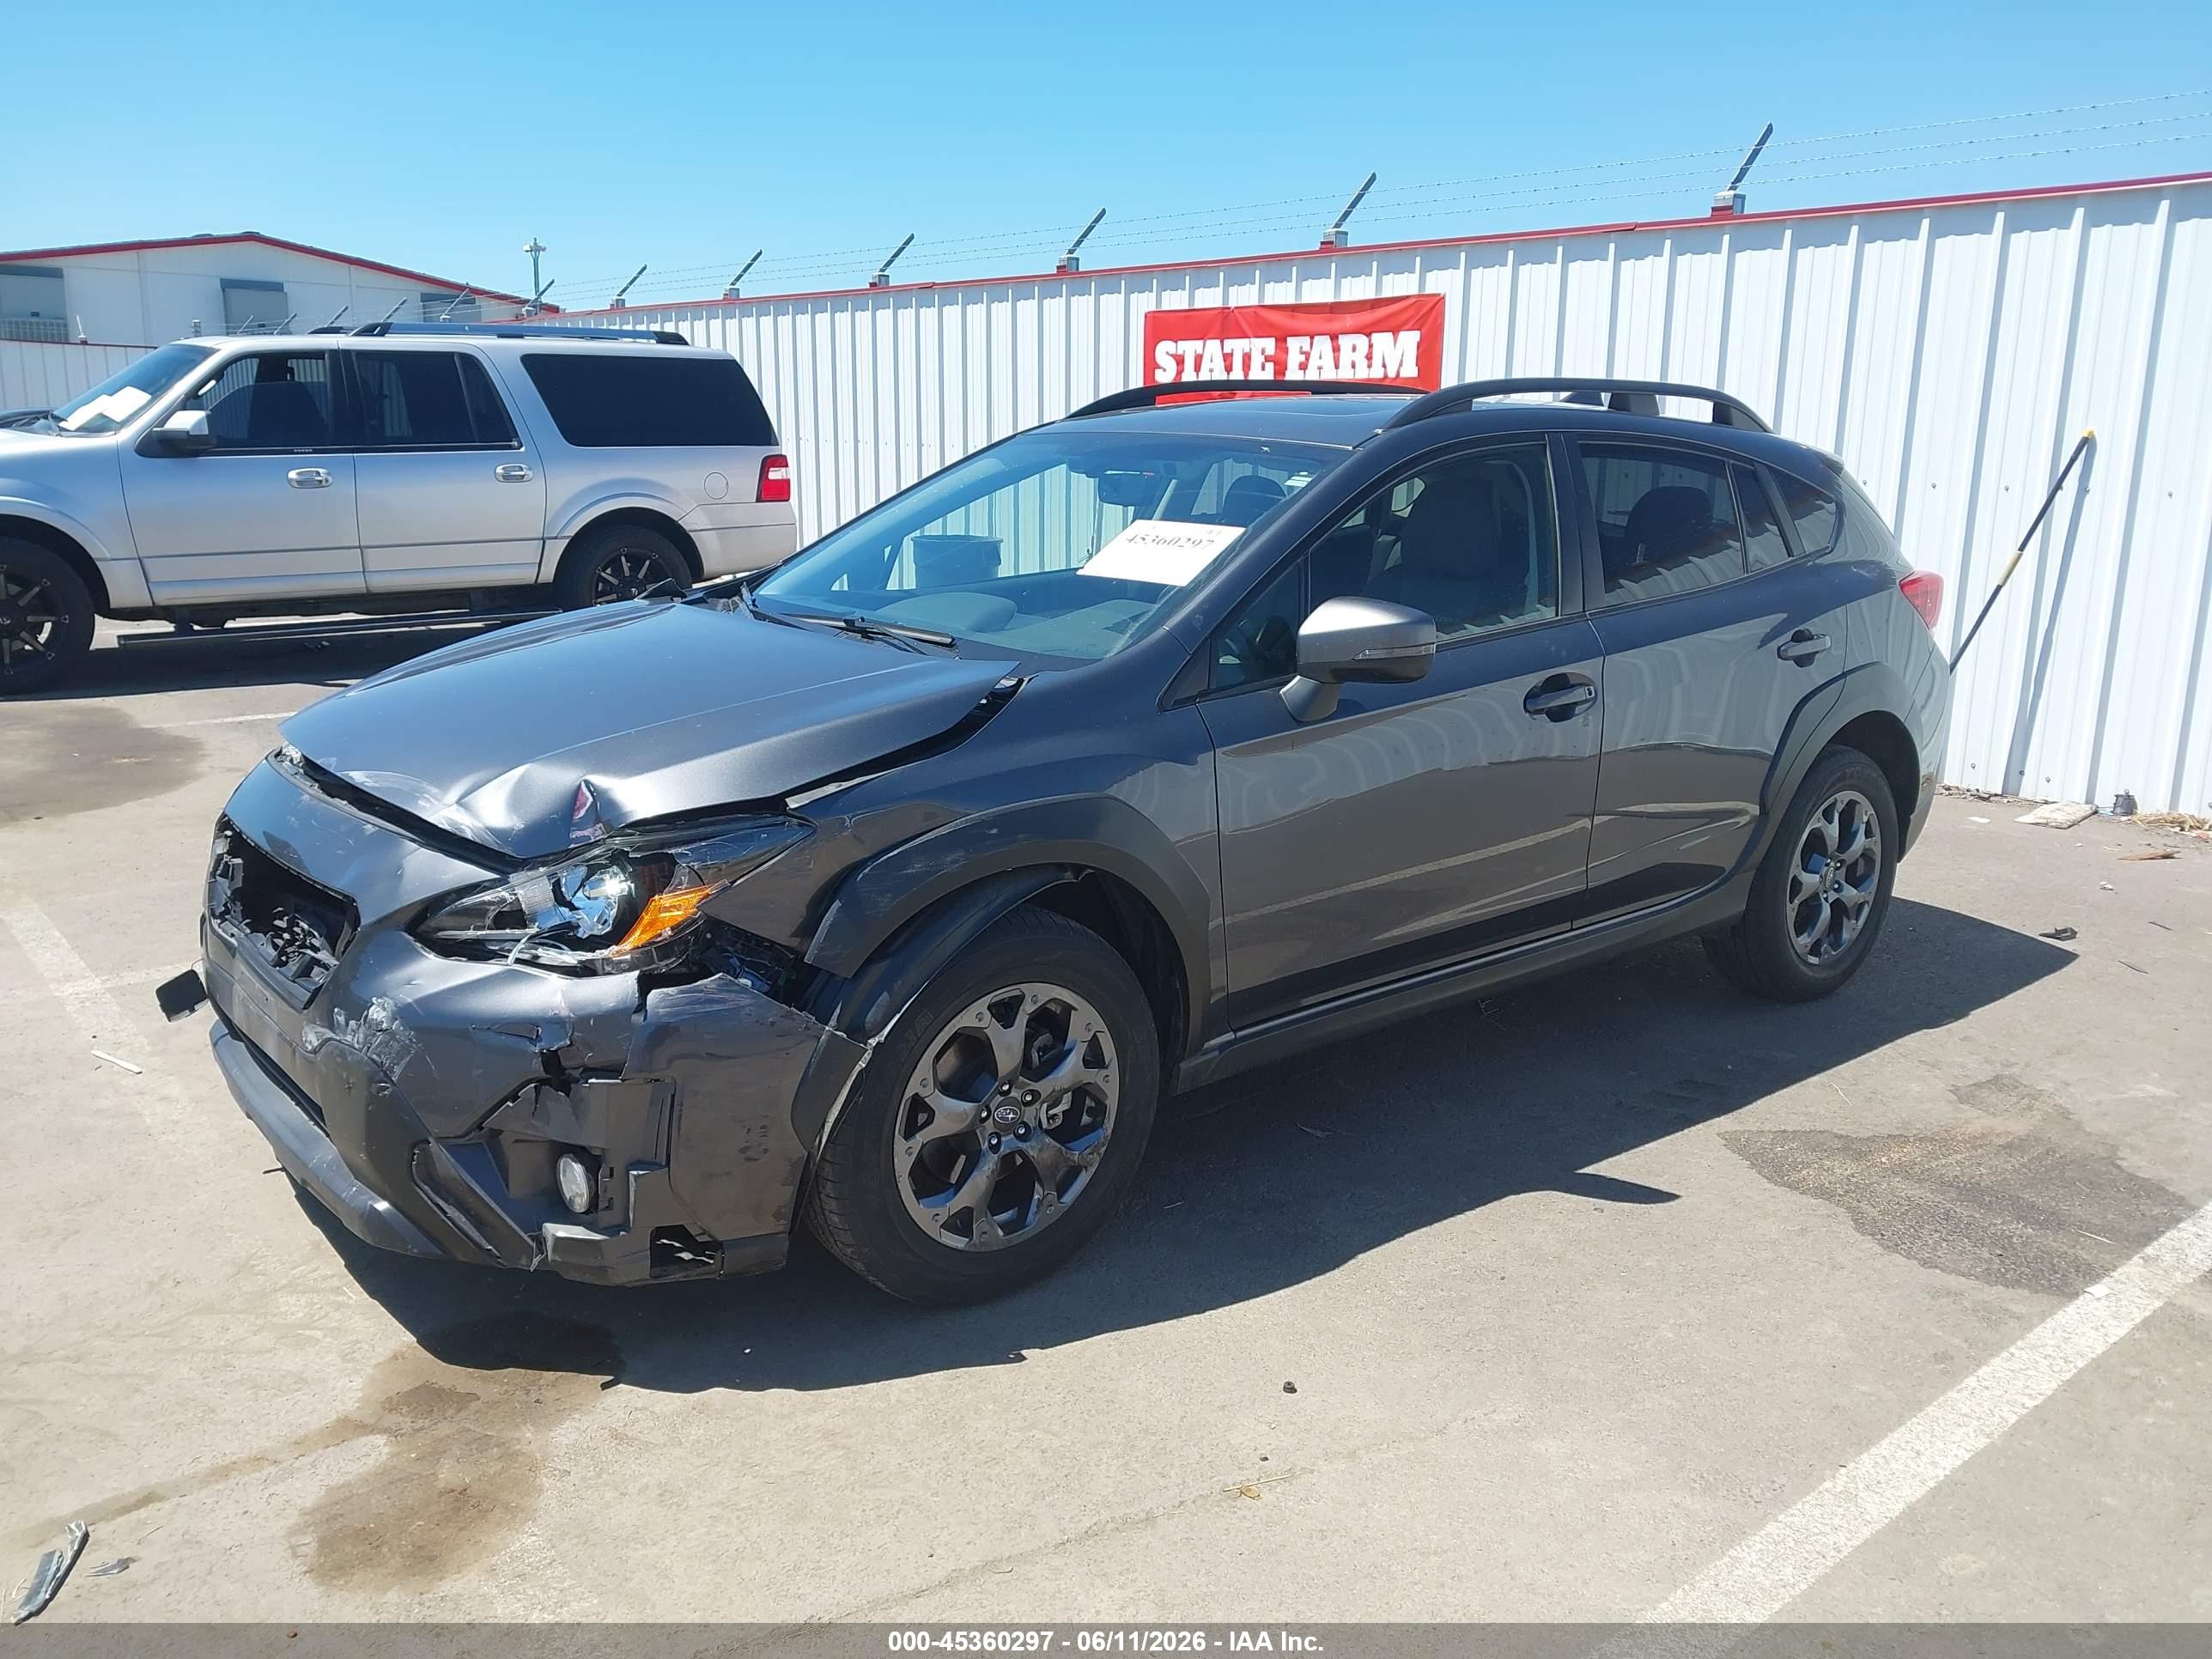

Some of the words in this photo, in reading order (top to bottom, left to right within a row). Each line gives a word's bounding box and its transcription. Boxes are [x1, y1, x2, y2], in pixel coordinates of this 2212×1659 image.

[1154, 337, 1275, 383] STATE
[1285, 331, 1421, 380] FARM
[1127, 534, 1215, 550] 45360297
